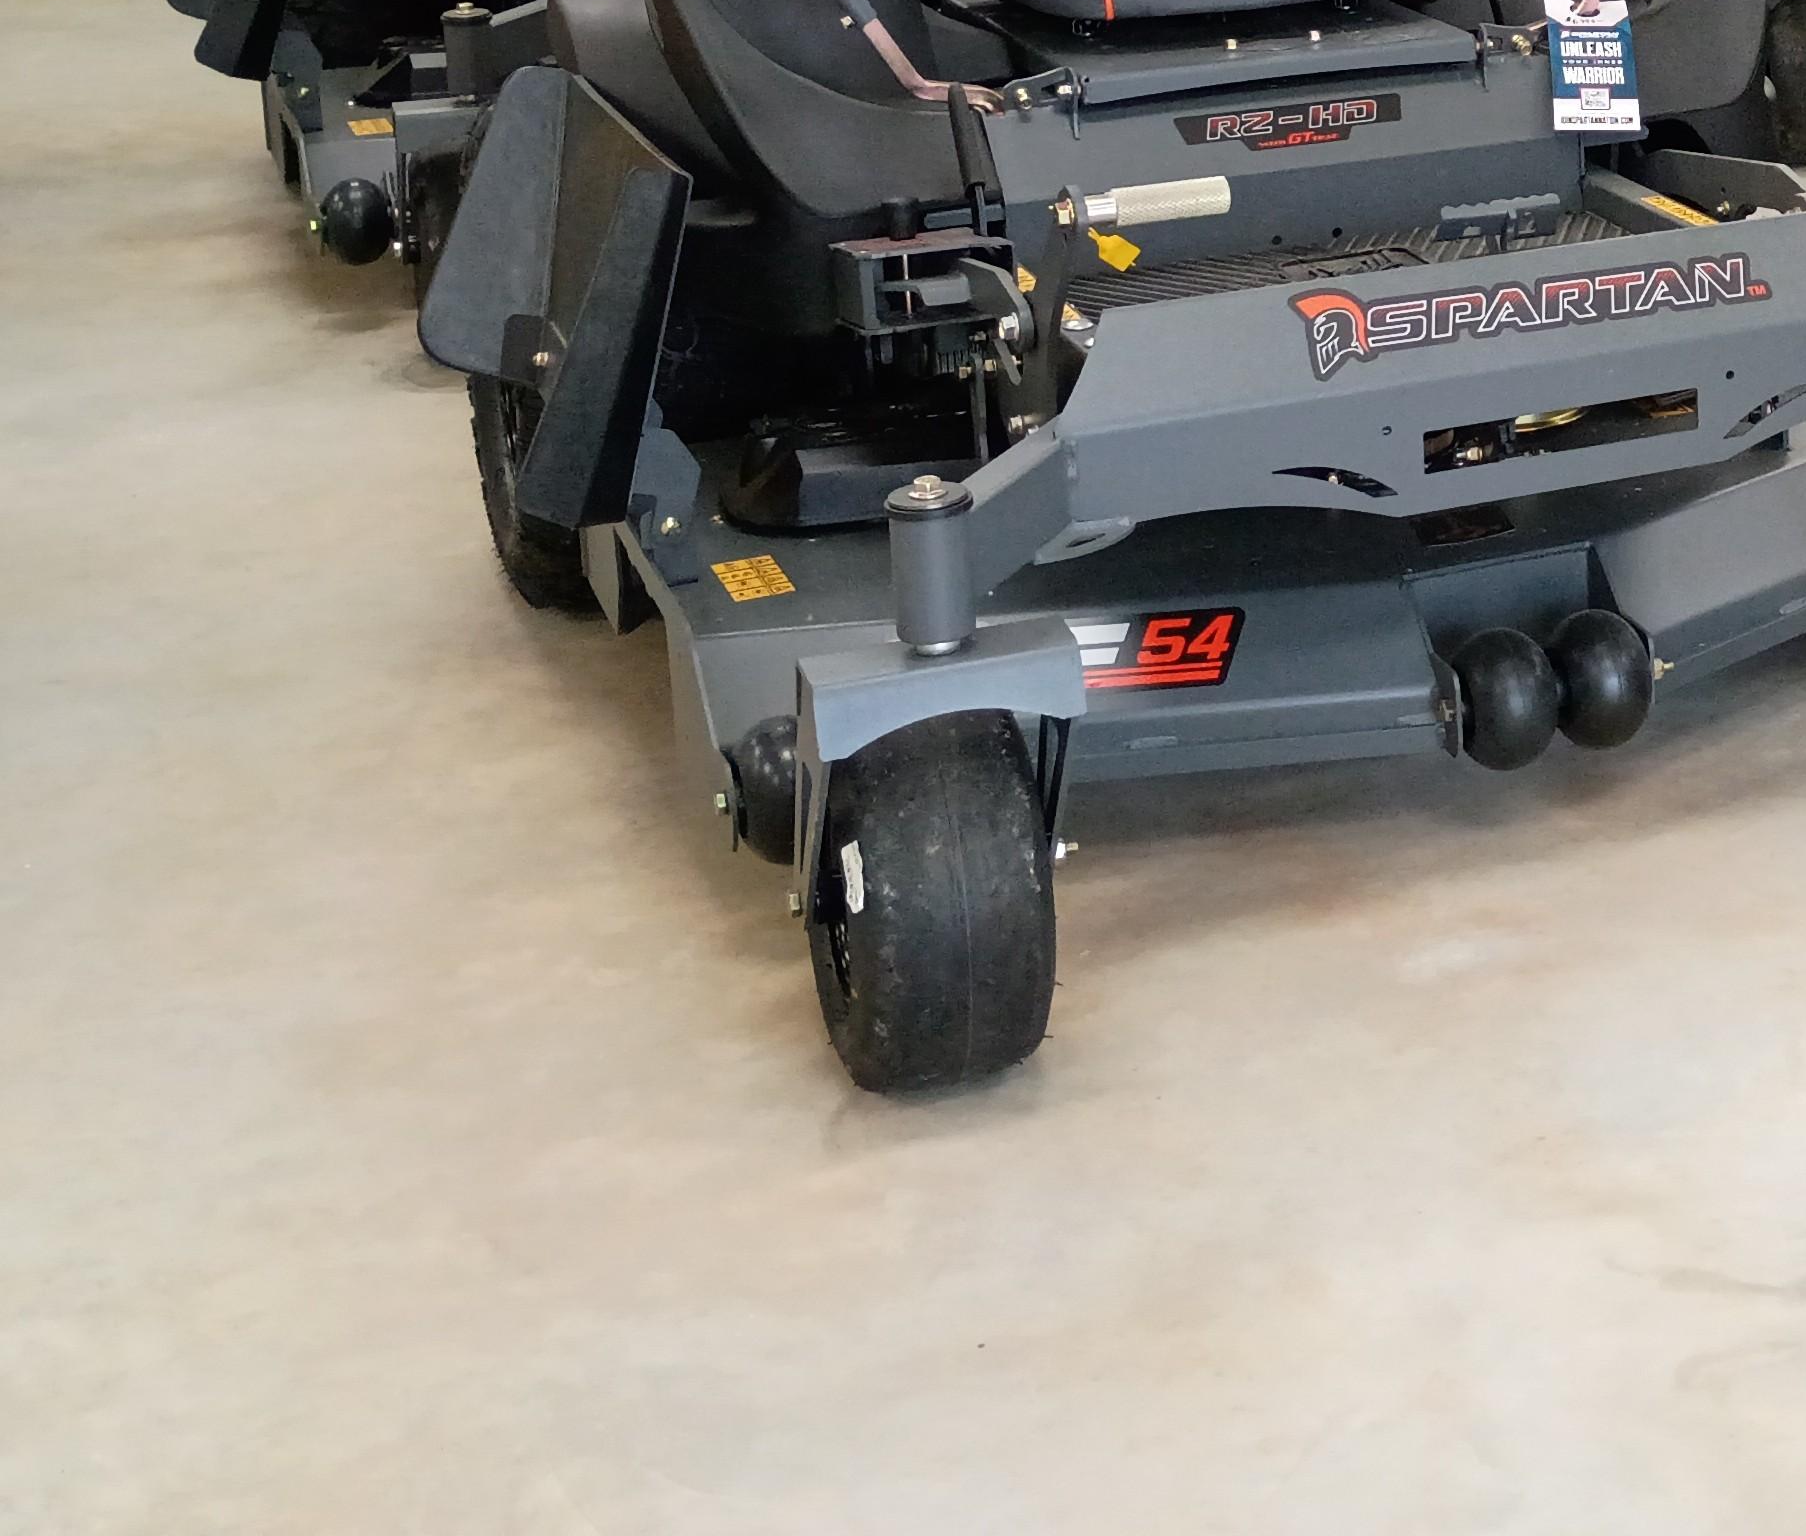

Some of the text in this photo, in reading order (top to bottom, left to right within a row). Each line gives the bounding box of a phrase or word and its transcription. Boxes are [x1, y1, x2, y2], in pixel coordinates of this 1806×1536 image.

[1560, 41, 1622, 57] UNLEASH
[1562, 66, 1625, 85] WARRIOR
[1207, 99, 1377, 140] RZ-HD
[1288, 130, 1314, 145] GT
[1366, 258, 1745, 348] SPARTAN
[1138, 613, 1235, 664] 54
